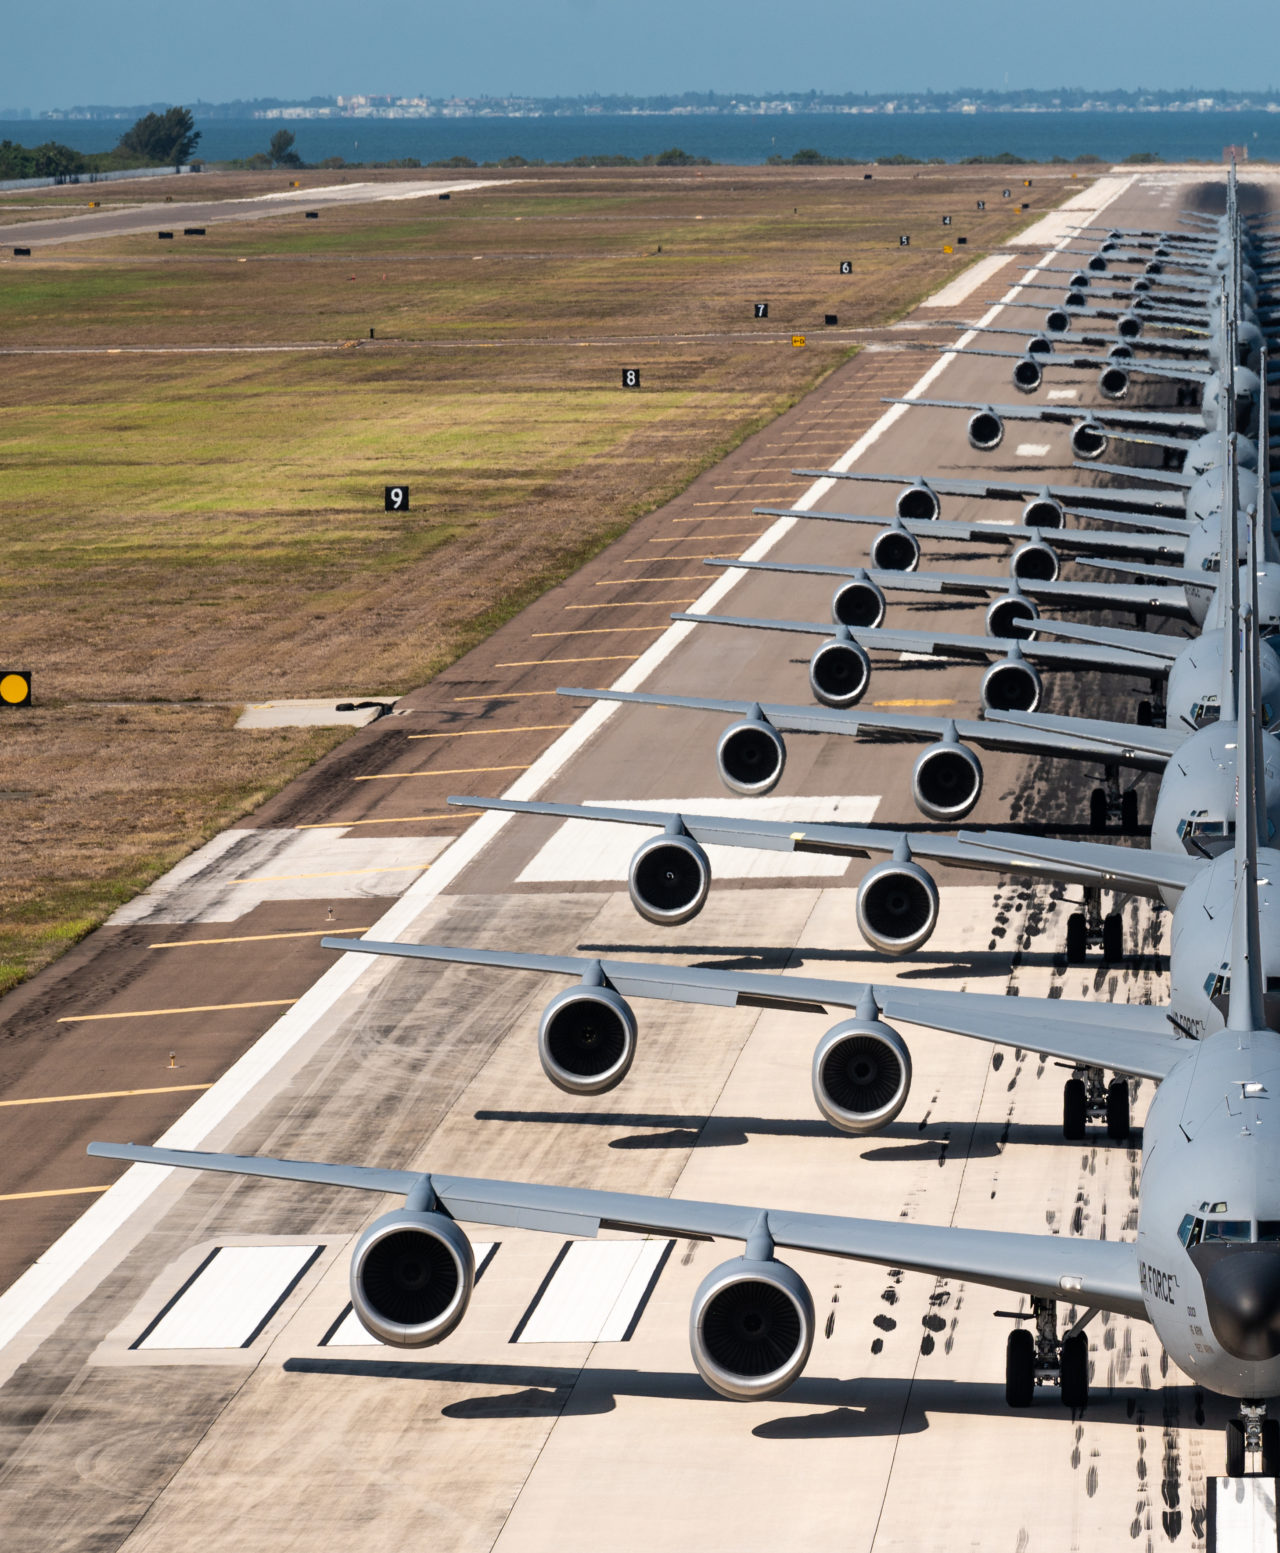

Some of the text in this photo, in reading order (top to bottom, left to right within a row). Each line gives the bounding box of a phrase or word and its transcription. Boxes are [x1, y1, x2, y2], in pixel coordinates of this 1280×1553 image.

[842, 262, 851, 273] 6
[757, 304, 765, 317] 7
[626, 370, 636, 386] 8
[390, 488, 403, 509] 9
[1148, 1265, 1175, 1305] FORCE
